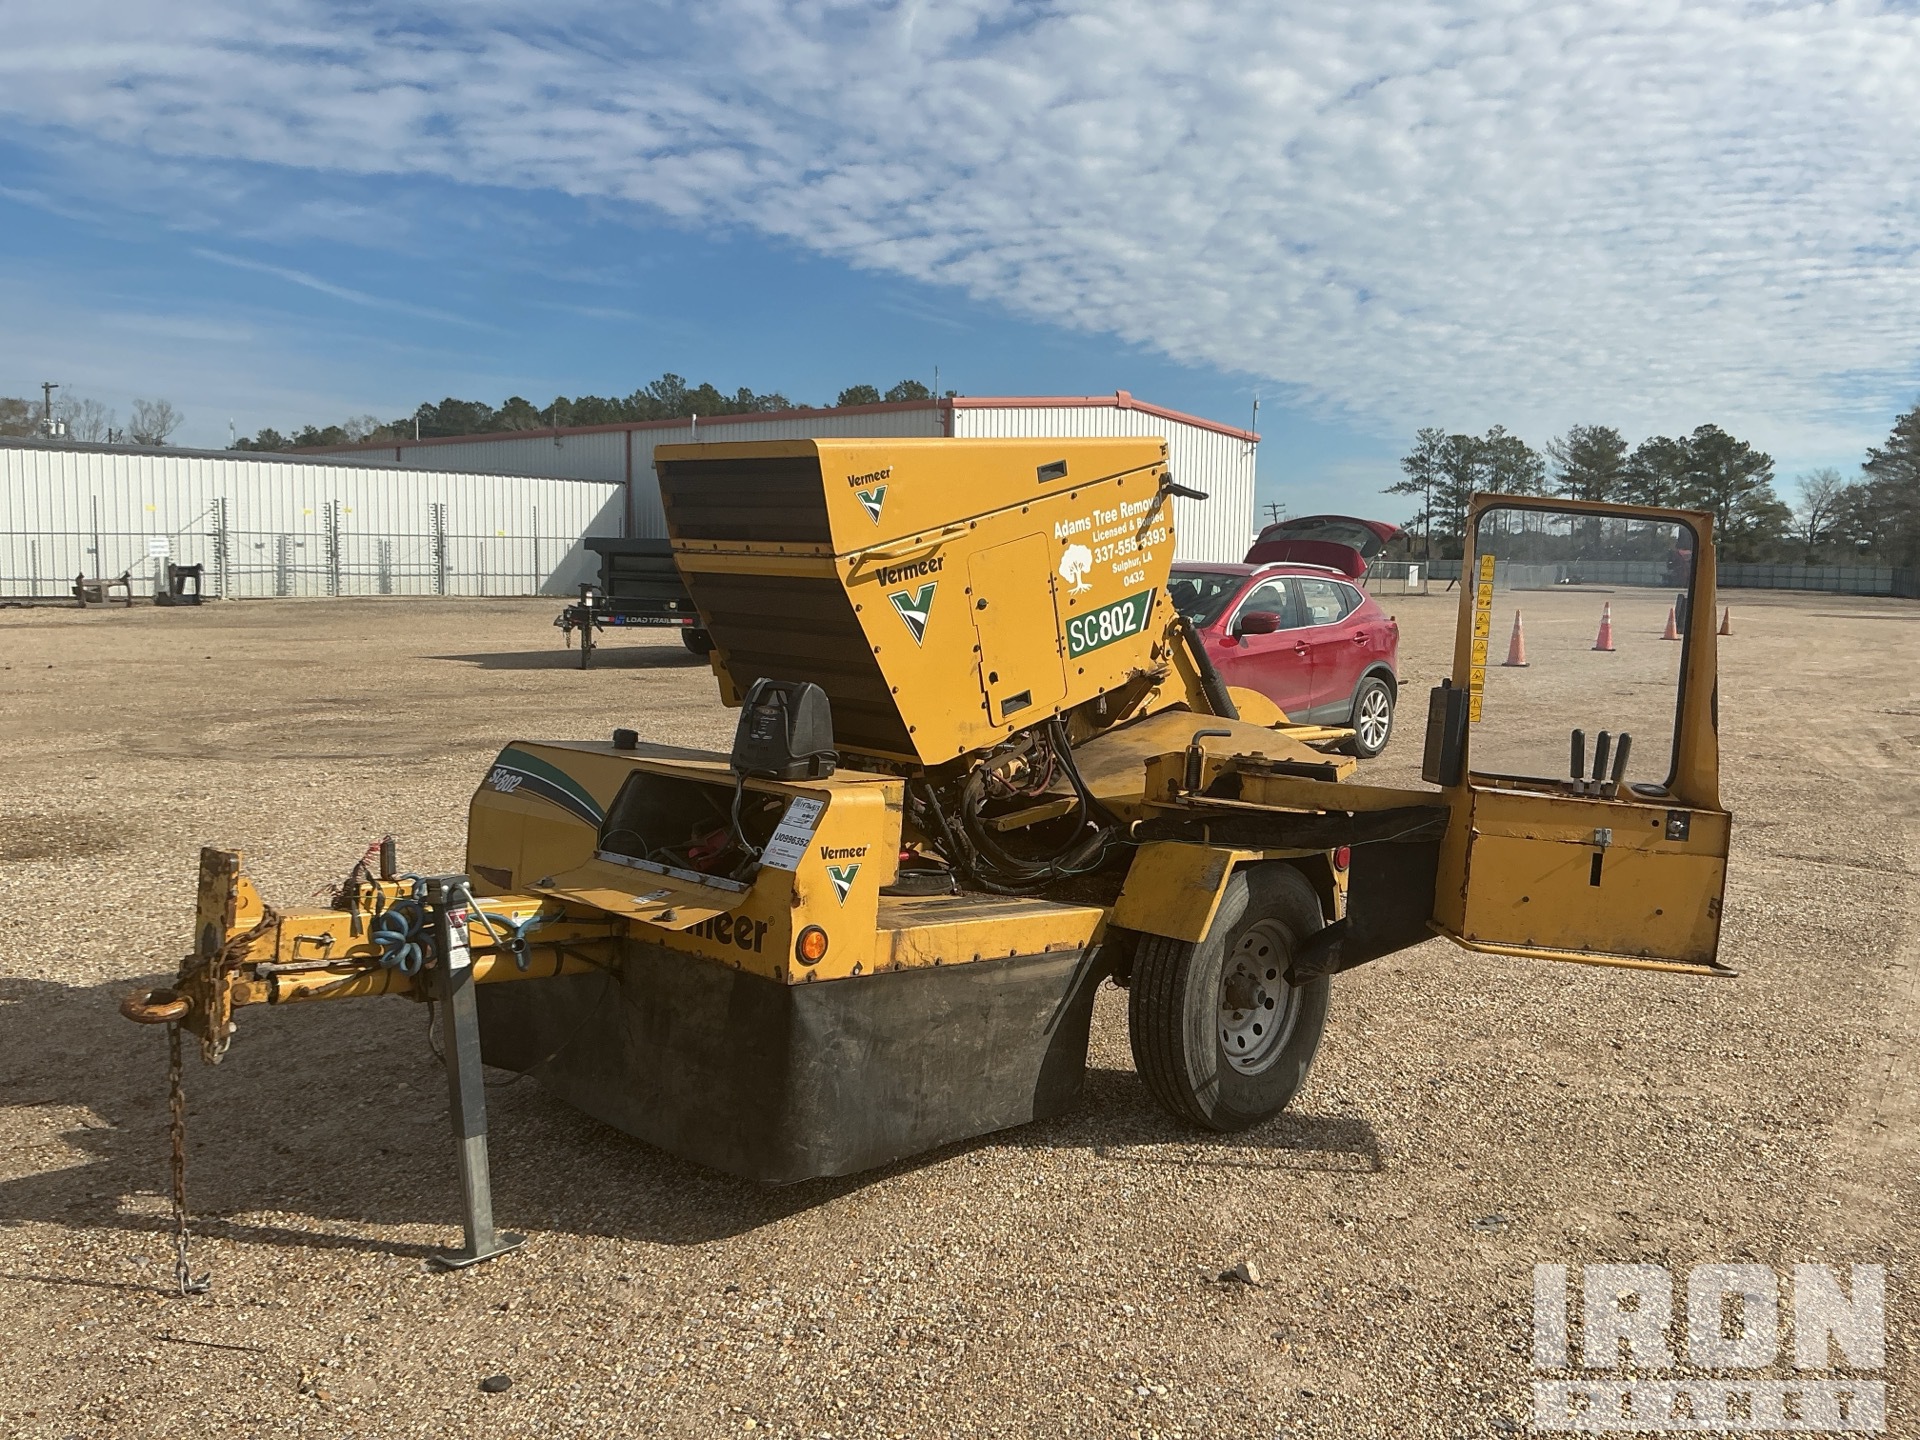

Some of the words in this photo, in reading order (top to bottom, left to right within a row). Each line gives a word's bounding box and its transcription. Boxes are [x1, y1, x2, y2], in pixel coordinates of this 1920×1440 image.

[847, 469, 890, 487] Vermeer
[1054, 517, 1091, 539] Adams
[1092, 508, 1118, 526] Tree
[1120, 494, 1163, 518] Removal
[1092, 527, 1127, 542] Licensed
[1129, 519, 1135, 530] &
[1137, 510, 1164, 528] Bonded
[875, 556, 944, 587] Vermeer
[1112, 556, 1141, 574] Sulphur,
[1142, 551, 1152, 563] LA
[1123, 570, 1145, 587] 0432
[1070, 601, 1137, 652] SC802
[488, 768, 523, 793] SC802
[820, 846, 867, 859] Vermeer
